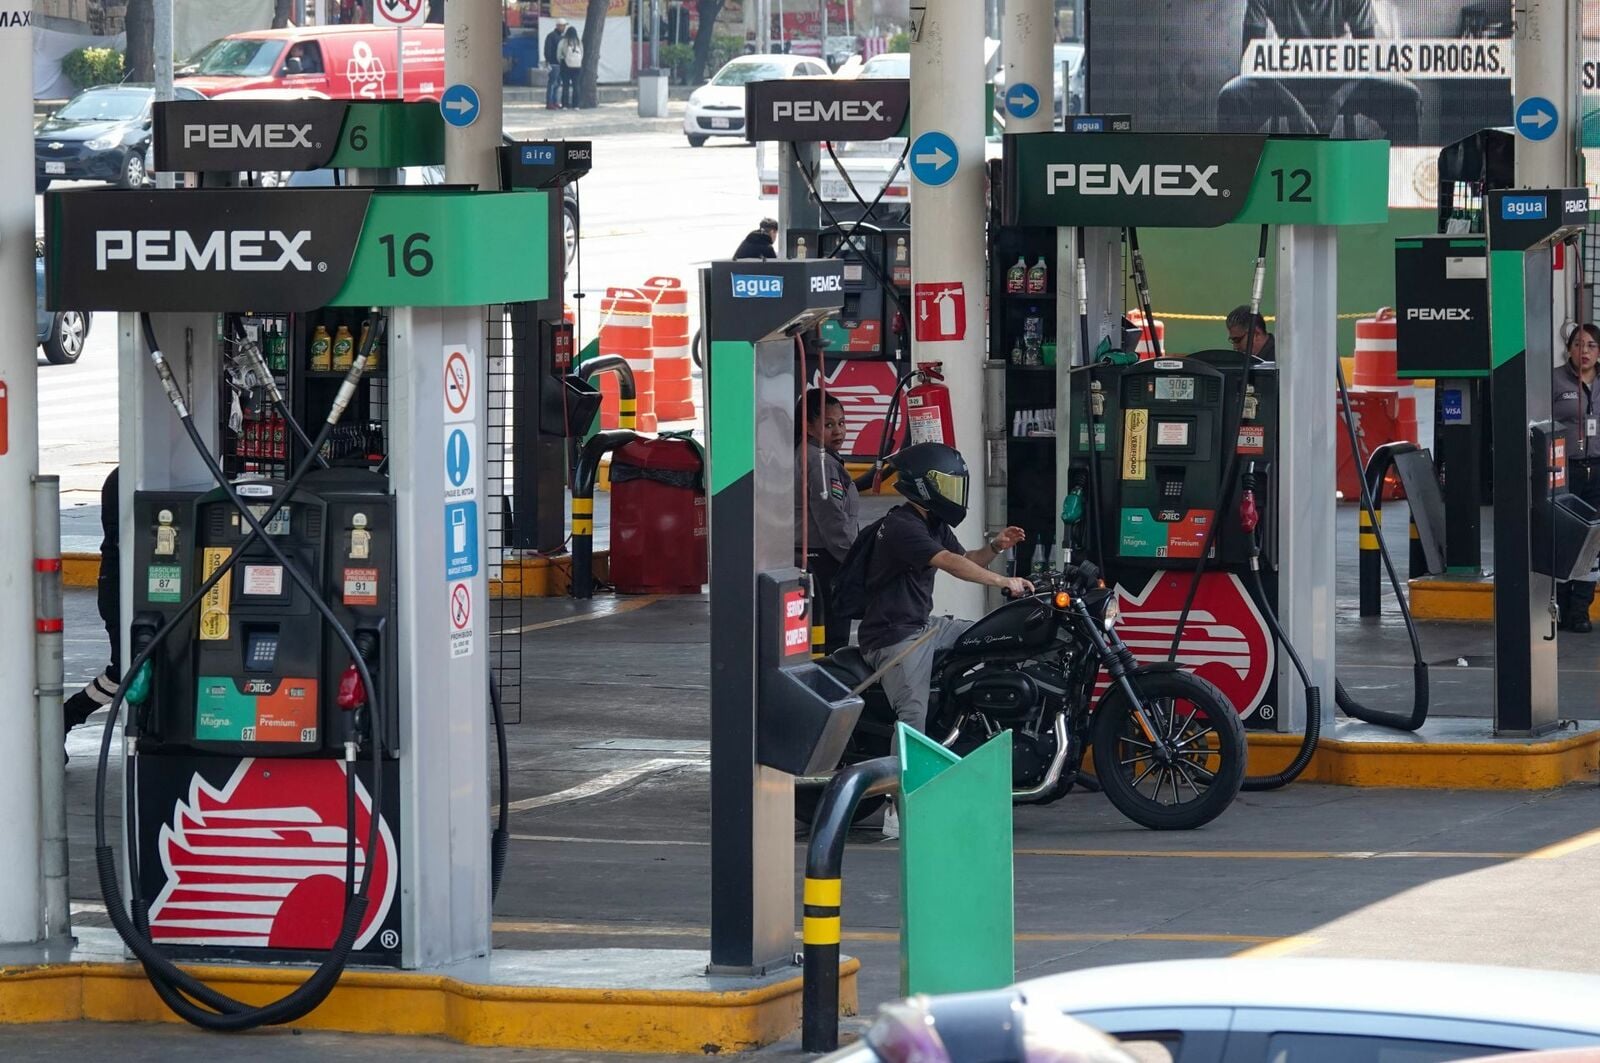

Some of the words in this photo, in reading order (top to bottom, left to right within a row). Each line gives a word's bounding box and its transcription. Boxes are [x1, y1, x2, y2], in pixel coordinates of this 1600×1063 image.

[1254, 41, 1338, 72] ALÉJATE
[1344, 45, 1370, 72] DE
[1376, 45, 1413, 72] LAS
[1419, 44, 1506, 74] DROGAS,
[773, 101, 884, 121] PEMEX
[1076, 122, 1100, 132] agua
[1112, 122, 1130, 130] PEMEX
[184, 124, 312, 148] PEMEX
[350, 126, 368, 151] 6
[526, 150, 552, 159] aire
[568, 150, 591, 160] PEMEX
[1046, 164, 1218, 196] PEMEX
[1271, 169, 1312, 202] 12
[1507, 202, 1542, 215] agua
[1565, 200, 1588, 213] PEMEX
[96, 230, 312, 270] PEMEX
[378, 232, 434, 278] 16
[736, 279, 780, 295] agua
[810, 275, 842, 292] PEMEX
[1407, 308, 1470, 320] PEMEX
[159, 579, 170, 588] 87
[355, 582, 366, 591] 91
[201, 718, 230, 727] Magna
[260, 718, 296, 727] Premium
[242, 729, 252, 740] 87
[303, 730, 312, 740] 91
